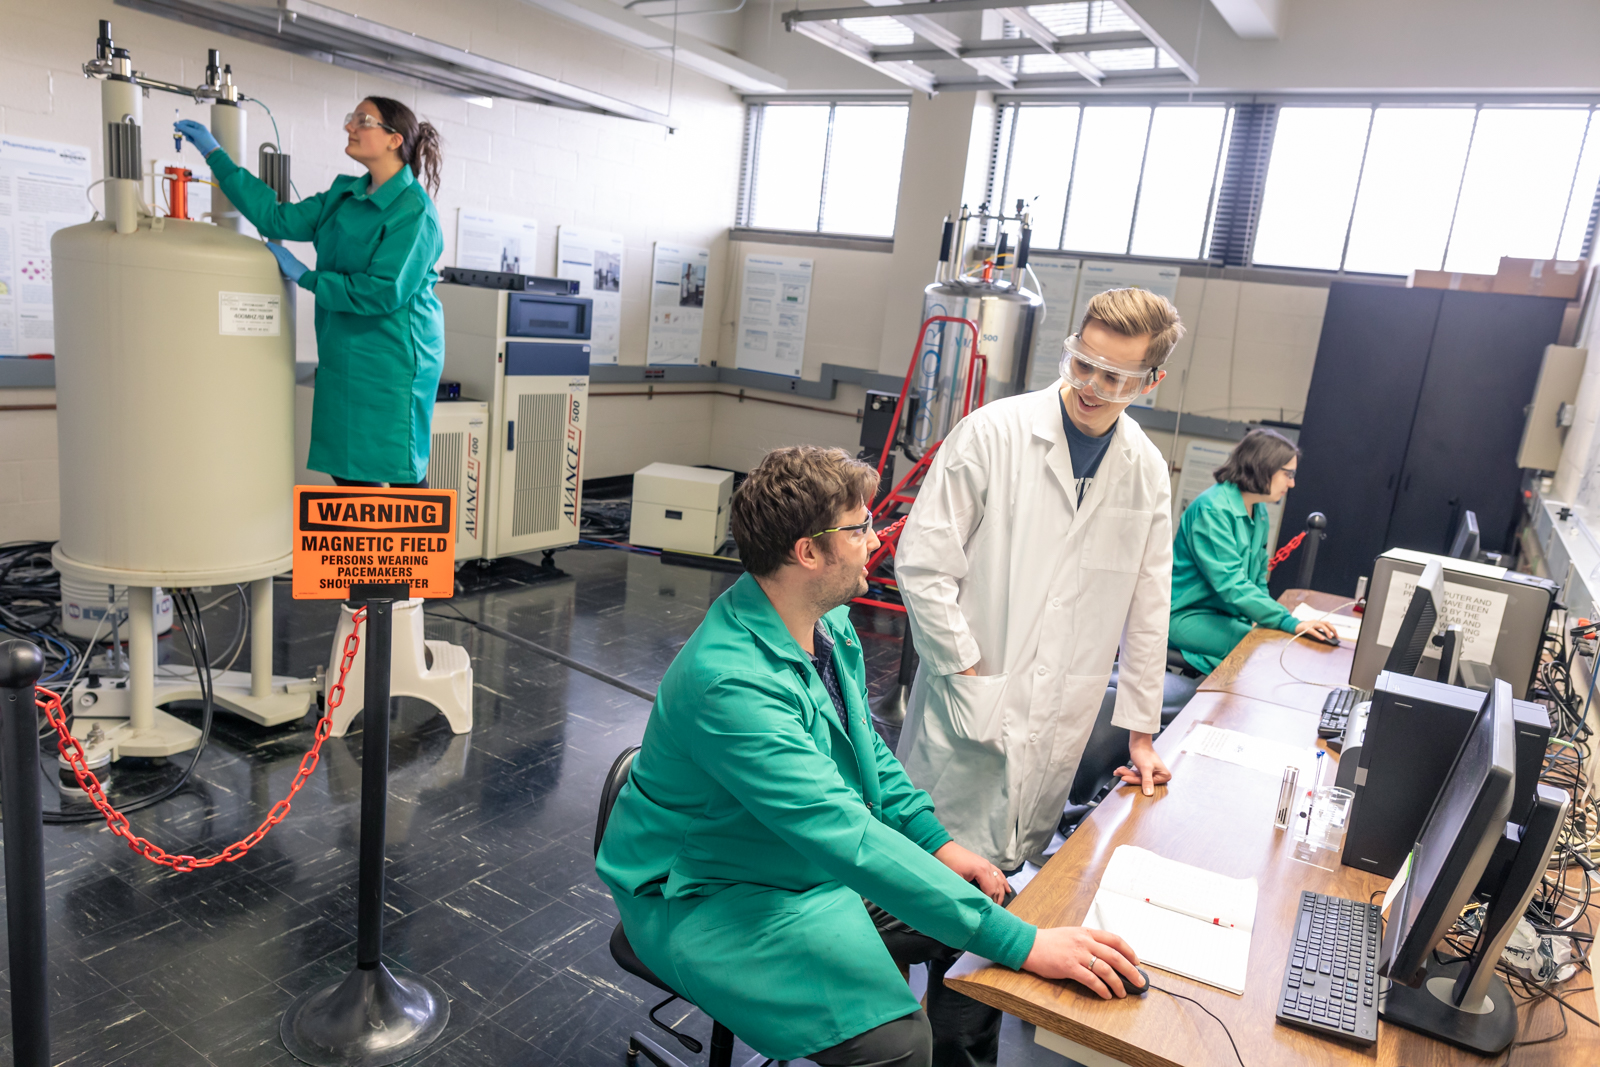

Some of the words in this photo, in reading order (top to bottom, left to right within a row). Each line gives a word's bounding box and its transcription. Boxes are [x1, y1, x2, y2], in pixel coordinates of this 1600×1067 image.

[983, 333, 998, 342] 500
[571, 400, 580, 423] 500
[567, 428, 576, 441] II
[471, 437, 479, 456] 400
[467, 460, 475, 471] II
[563, 442, 579, 527] AVANCE
[465, 471, 478, 540] AVANCE
[317, 502, 436, 523] WARNING
[301, 535, 394, 552] MAGNETIC
[400, 537, 448, 553] FIELD
[321, 555, 374, 566] PERSONS
[377, 555, 429, 566] WEARING
[337, 567, 413, 577] PACEMAKERS
[1465, 602, 1489, 614] BEEN
[1473, 597, 1492, 607] AND
[1449, 608, 1463, 616] BY
[1463, 610, 1480, 620] THE
[1445, 615, 1461, 624] LAB
[1461, 619, 1481, 628] AND
